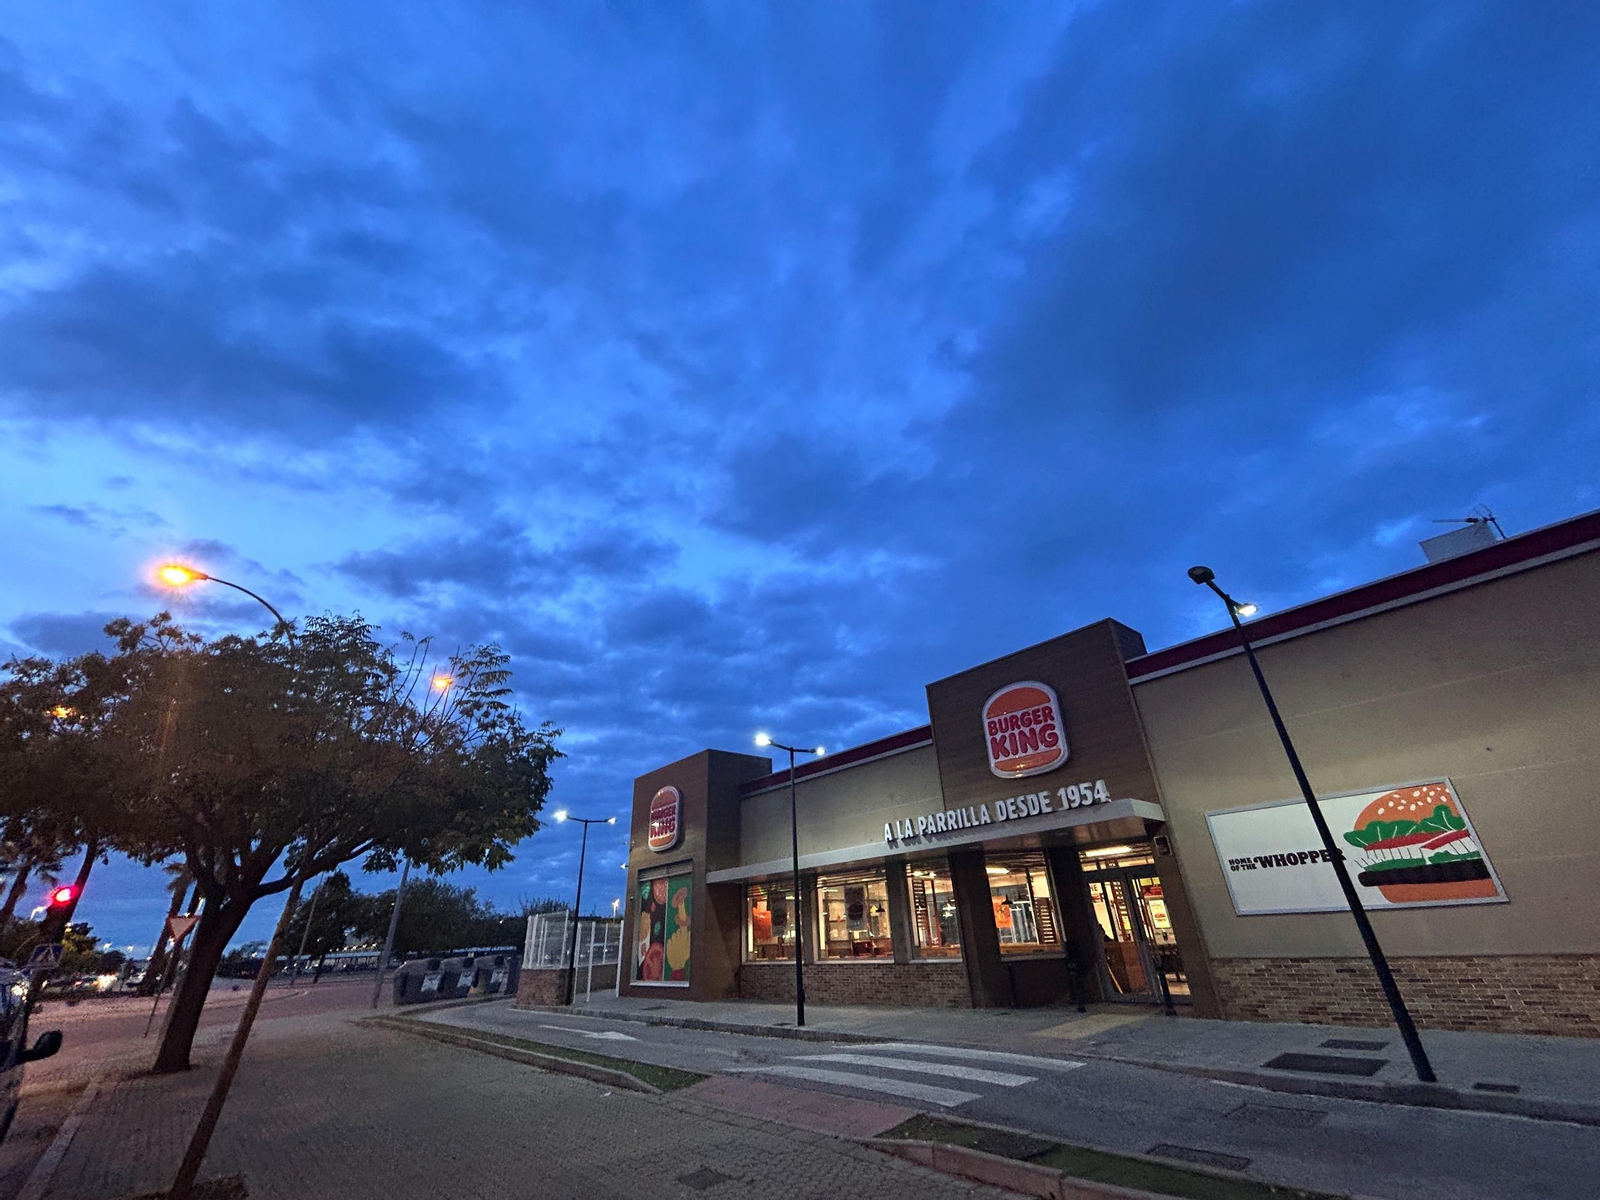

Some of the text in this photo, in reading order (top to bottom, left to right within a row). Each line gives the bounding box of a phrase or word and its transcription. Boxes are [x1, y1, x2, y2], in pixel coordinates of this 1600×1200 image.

[987, 706, 1055, 737] BURGER
[990, 723, 1059, 760] KING
[884, 780, 1111, 841] A LA PARRILLA DESDE 1954
[1228, 857, 1253, 866] HOME
[1240, 863, 1257, 871] THE
